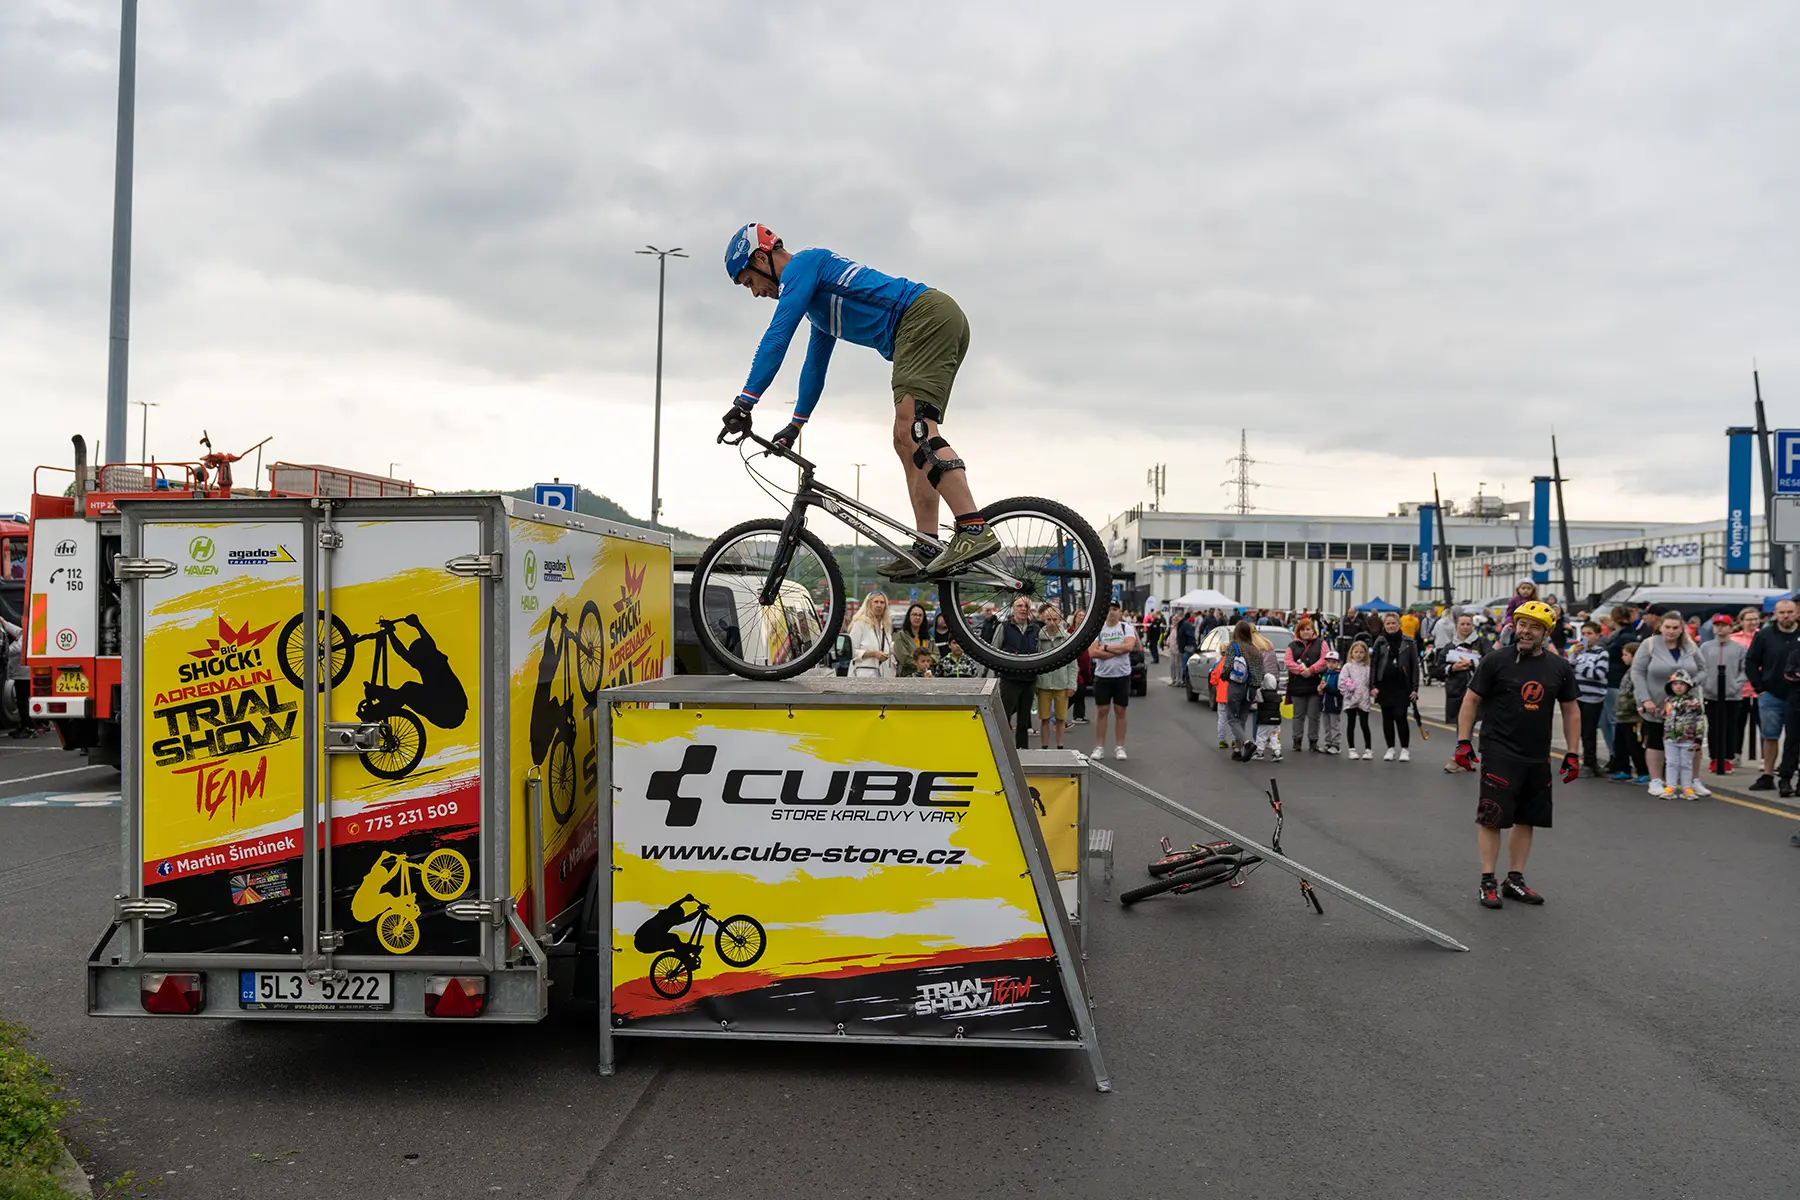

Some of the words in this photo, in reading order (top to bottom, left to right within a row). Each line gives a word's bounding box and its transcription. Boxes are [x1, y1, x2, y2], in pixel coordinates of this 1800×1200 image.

[1730, 509, 1743, 558] olympia
[228, 549, 278, 560] agados
[1655, 542, 1699, 558] FISCHER
[67, 568, 82, 579] 112
[184, 565, 219, 576] HAVEN
[544, 559, 567, 573] agados
[67, 580, 84, 591] 150
[609, 600, 641, 650] SHOCK!
[60, 633, 73, 643] 90
[220, 644, 237, 655] BIG
[608, 619, 652, 676] ADRENALIN
[64, 673, 82, 682] TPA
[178, 648, 262, 683] SHOCK!
[59, 682, 86, 692] 24-46
[154, 669, 273, 707] ADRENALIN
[153, 685, 298, 736] TRIAL
[152, 710, 298, 767] SHOW
[172, 755, 268, 822] TEAM
[722, 769, 979, 807] CUBE
[365, 816, 393, 832] 775
[399, 809, 424, 826] 231
[428, 802, 458, 819] 509
[770, 809, 828, 821] STORE
[830, 809, 915, 822] KARLOVY
[918, 811, 968, 823] VARY
[177, 850, 225, 874] Martin
[229, 836, 296, 862] Šimůnek
[568, 833, 592, 869] Martin
[641, 842, 966, 865] www.cube-store.cz
[242, 991, 254, 999] CZ
[260, 975, 303, 999] 5L3
[322, 976, 380, 1000] 5222
[916, 977, 993, 1000] TRIAL
[981, 975, 1032, 1008] TEAM
[914, 992, 992, 1015] SHOW
